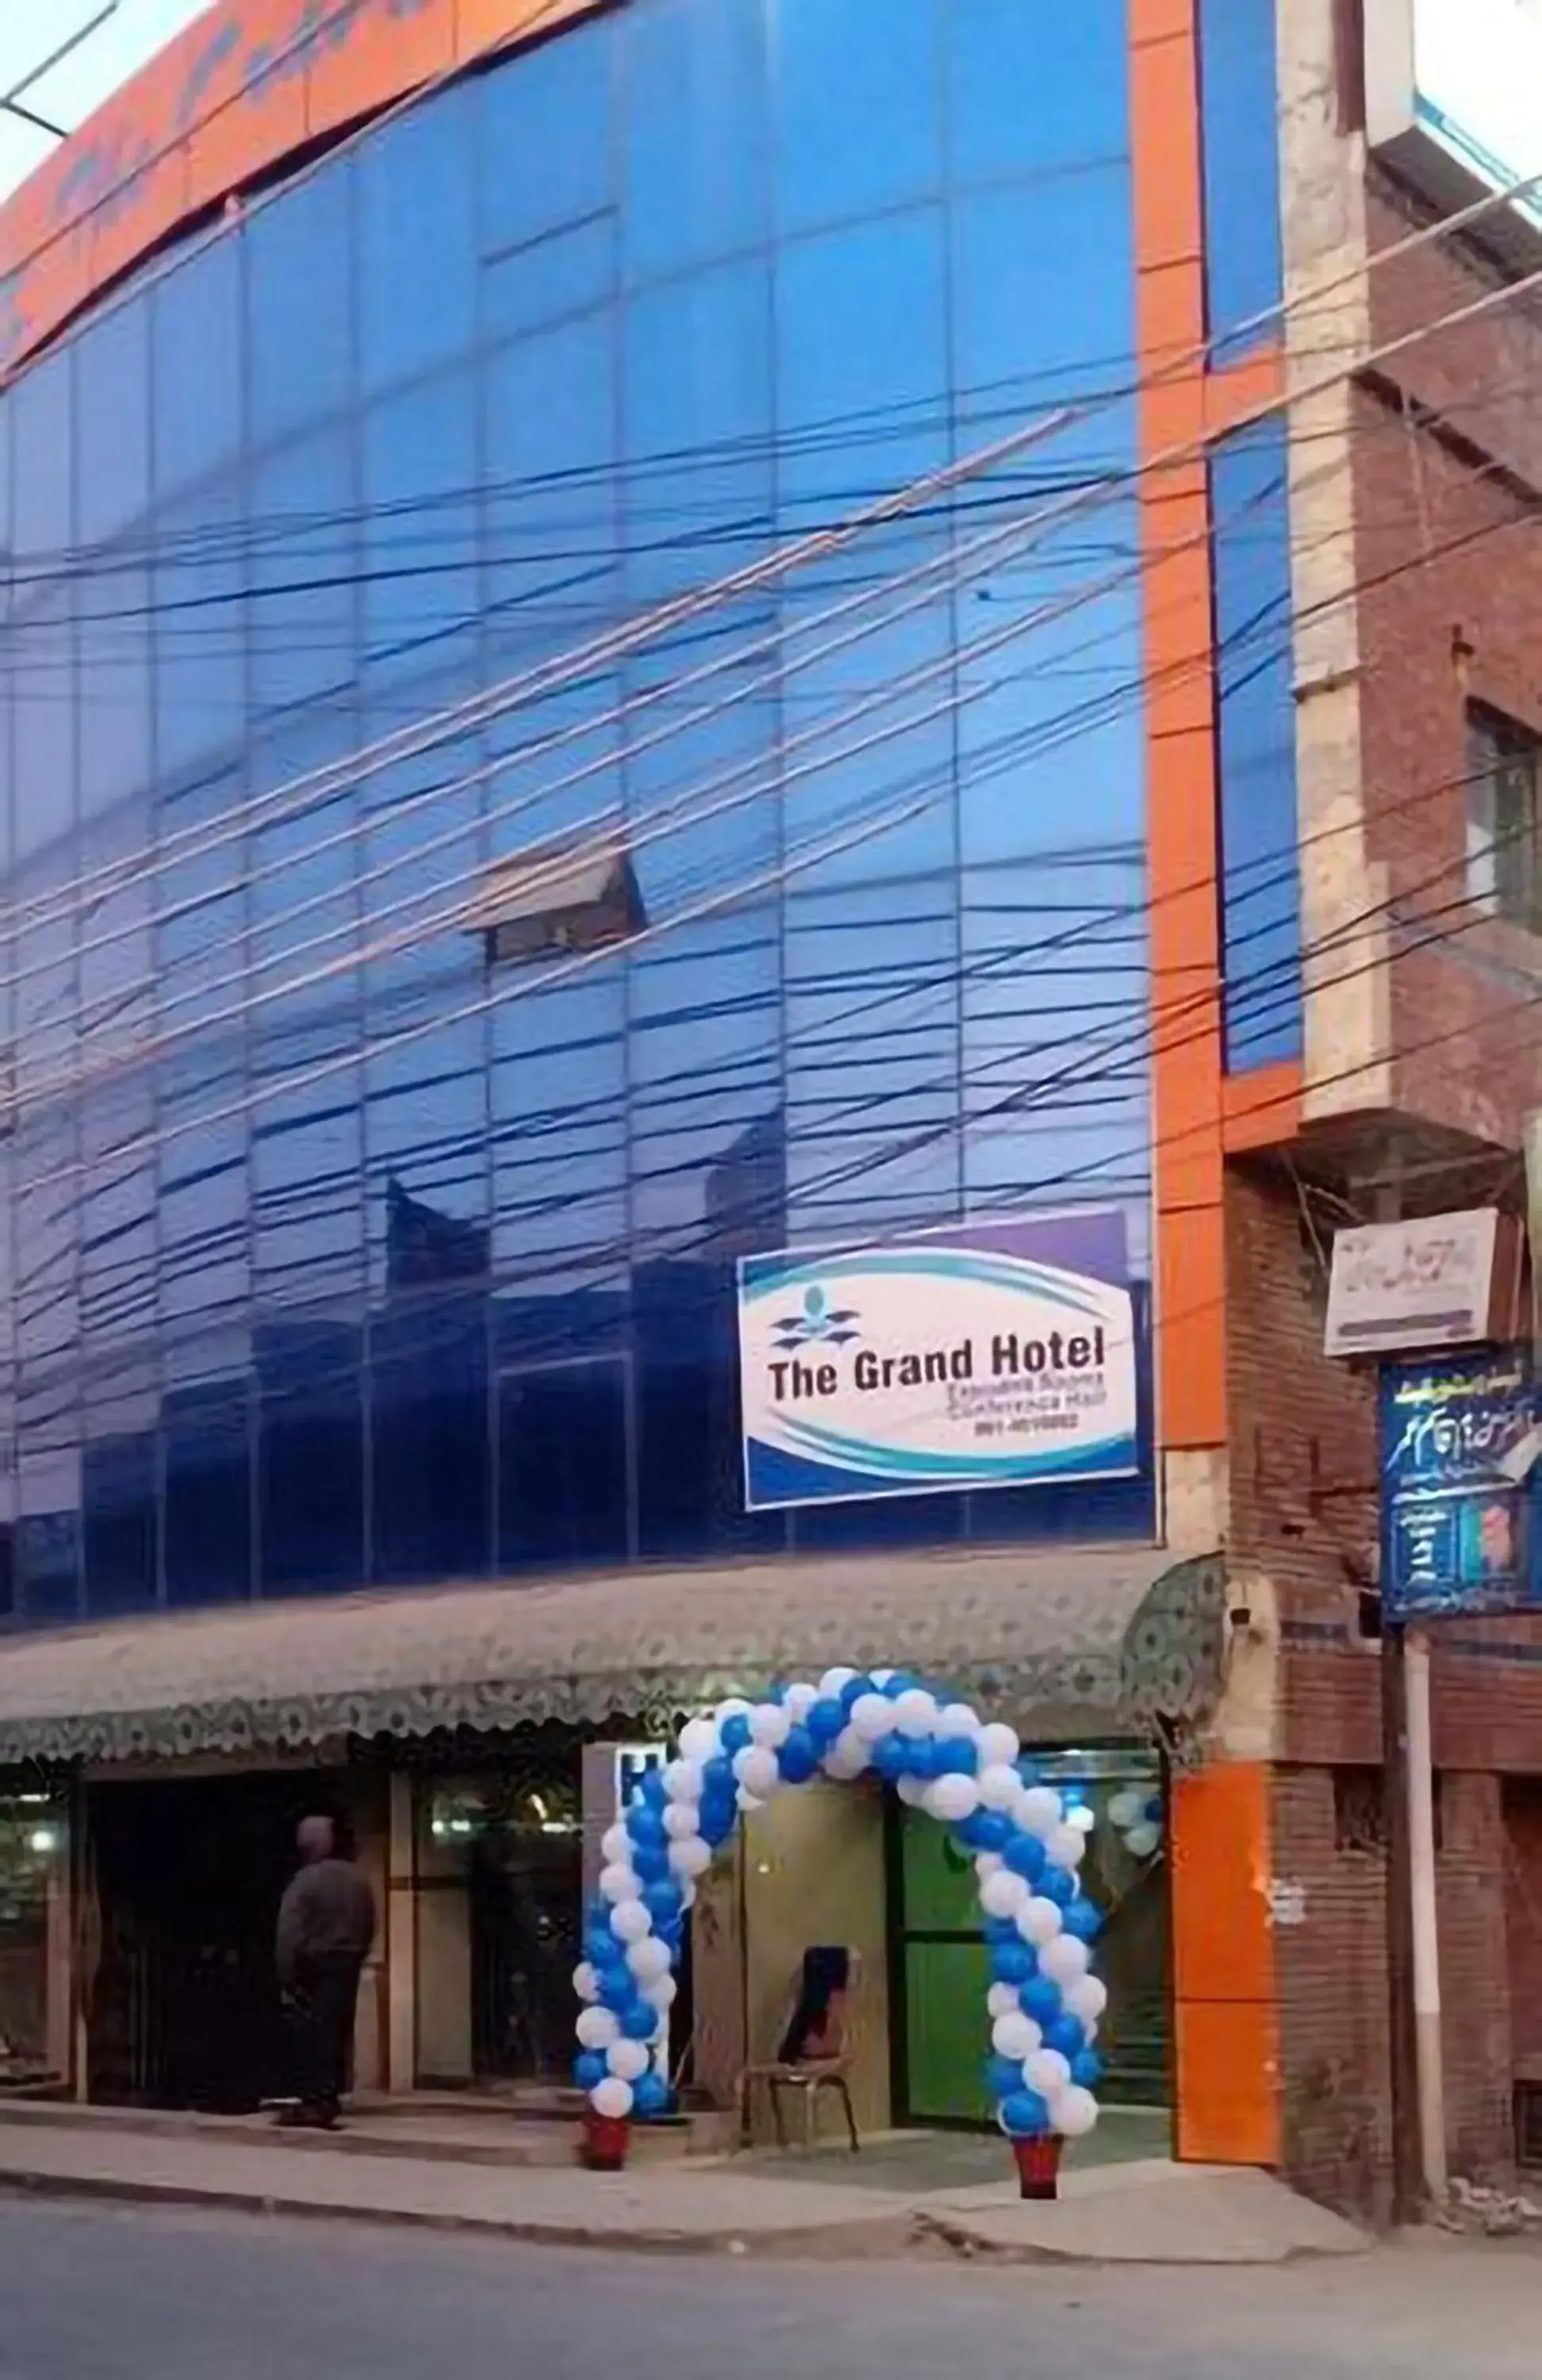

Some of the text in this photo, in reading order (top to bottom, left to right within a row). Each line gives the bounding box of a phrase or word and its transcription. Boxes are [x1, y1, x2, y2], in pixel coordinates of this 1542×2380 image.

[767, 1326, 1105, 1401] The Grand Hotel
